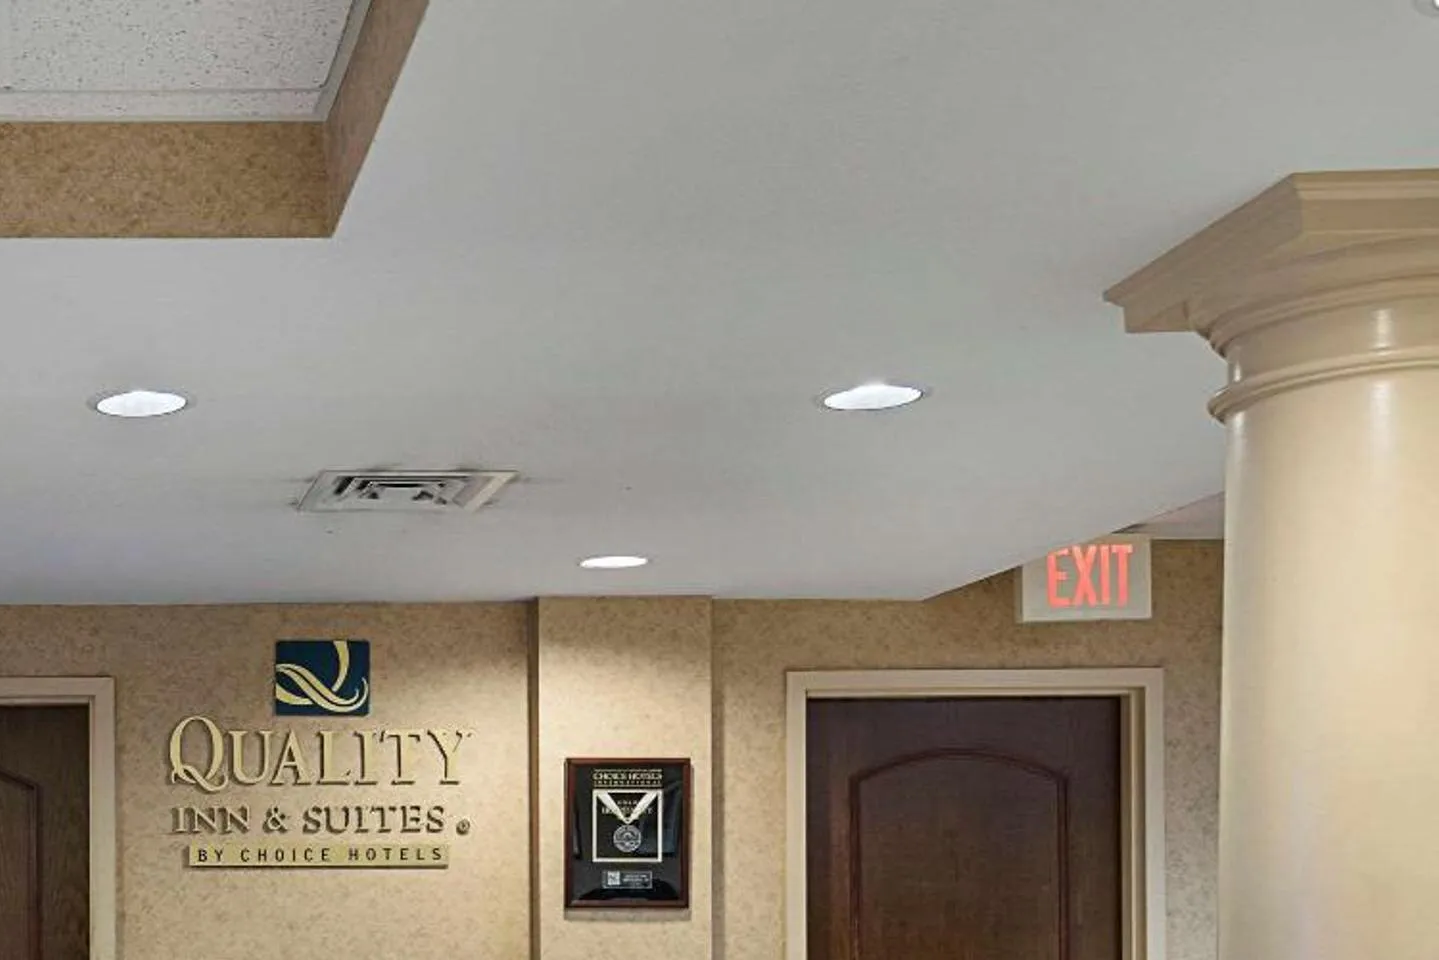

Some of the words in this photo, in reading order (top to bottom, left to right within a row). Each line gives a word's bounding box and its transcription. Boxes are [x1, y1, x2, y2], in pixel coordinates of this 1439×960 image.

[1046, 543, 1134, 609] EXIT
[169, 715, 468, 793] QUALITY
[171, 805, 251, 833] INN
[263, 805, 291, 833] &
[197, 848, 225, 863] BY
[240, 847, 332, 863] CHOICE
[347, 847, 443, 862] HOTELS
